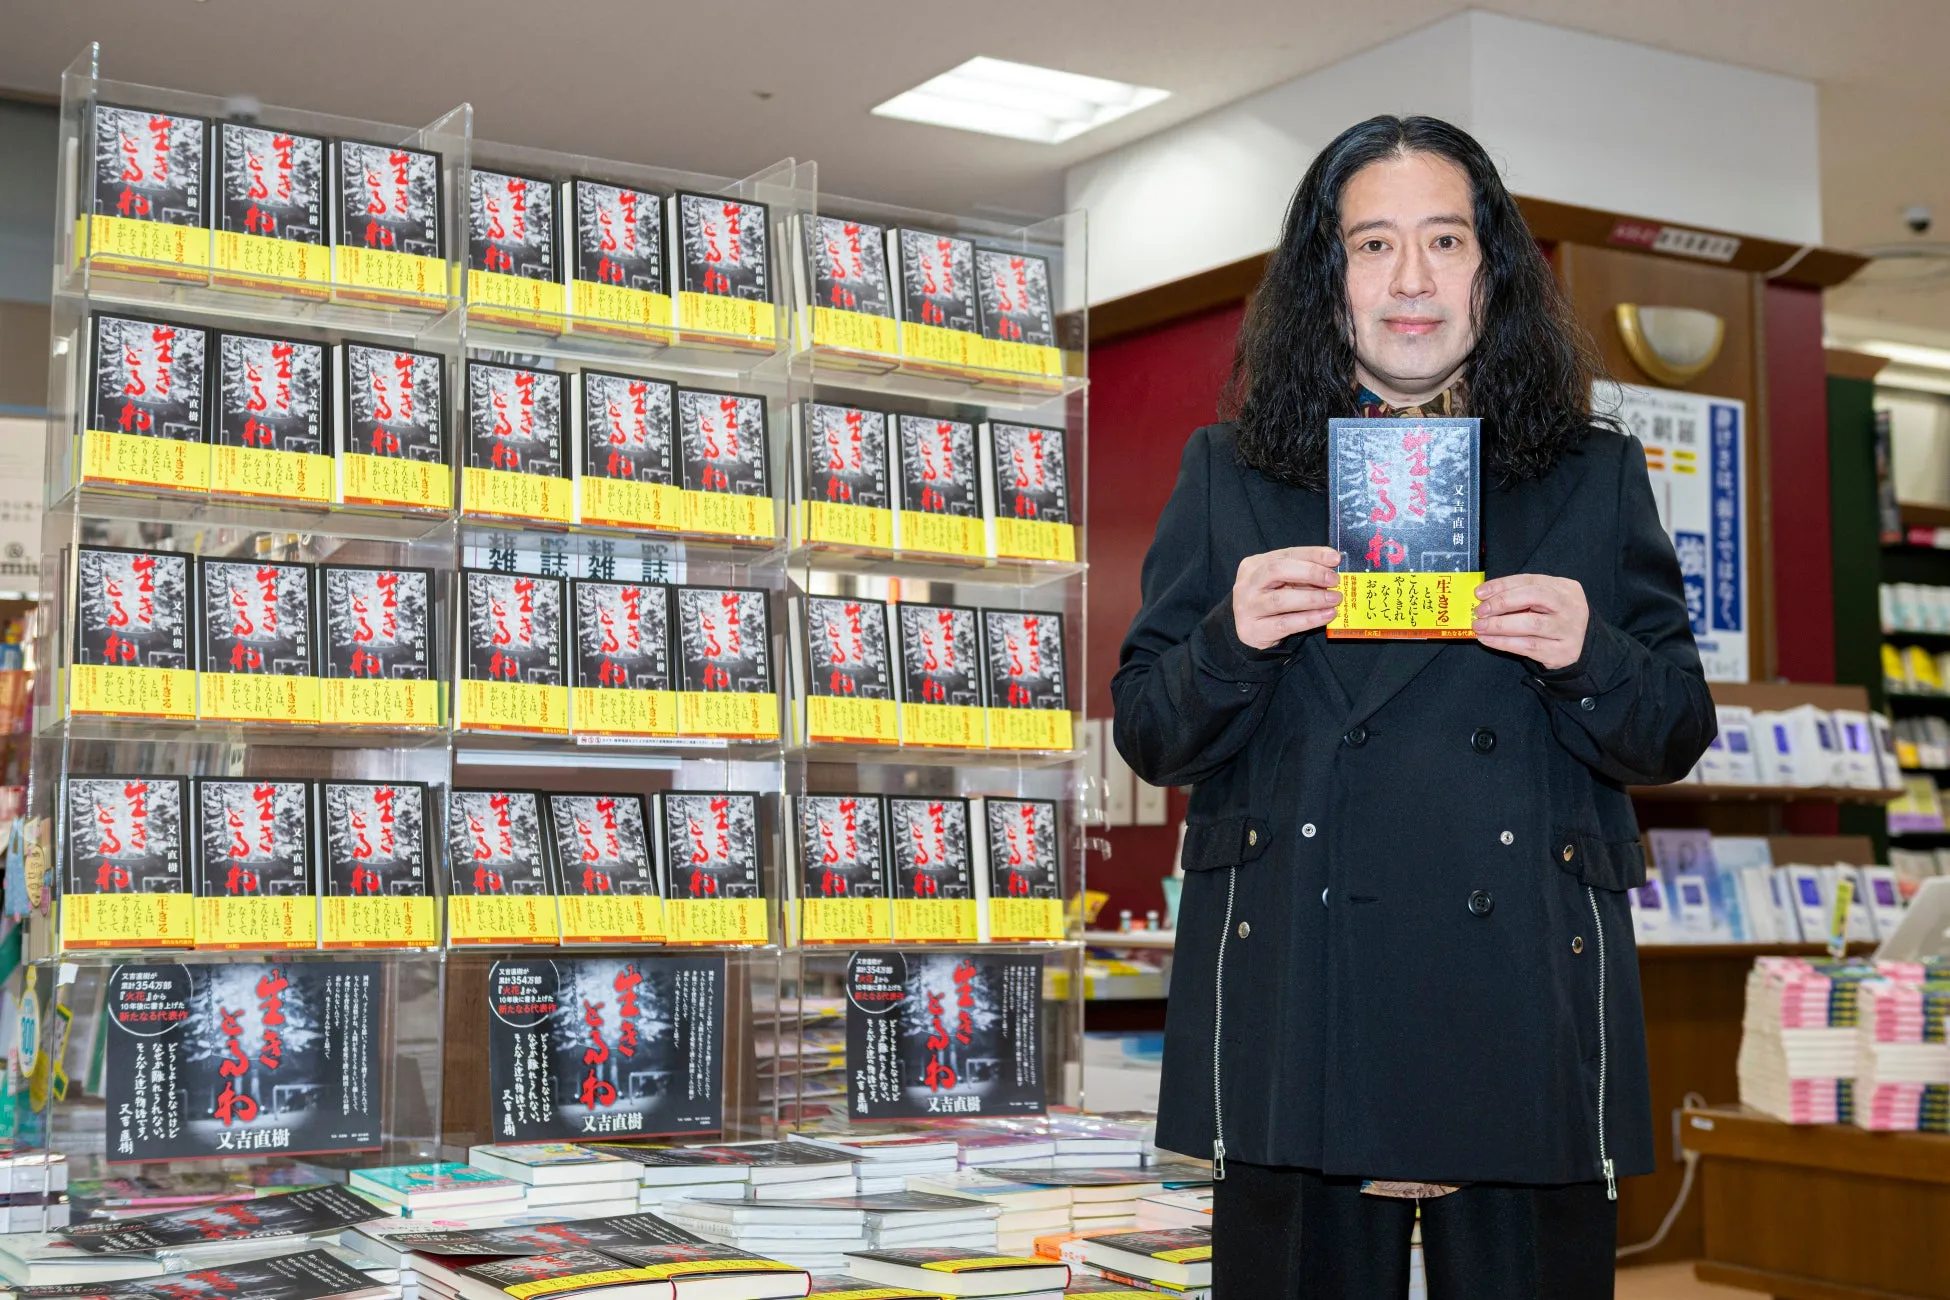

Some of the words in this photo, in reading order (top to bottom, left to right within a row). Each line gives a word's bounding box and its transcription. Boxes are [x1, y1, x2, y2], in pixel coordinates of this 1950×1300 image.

[116, 134, 150, 216] とるわ
[148, 113, 173, 181] 生き
[272, 132, 295, 199] 生き
[388, 148, 410, 214] 生き
[243, 152, 275, 233] とるわ
[364, 168, 394, 247] とるわ
[506, 176, 527, 239] 生き
[618, 188, 638, 251] 生き
[483, 194, 512, 271] とるわ
[596, 207, 623, 283] とるわ
[703, 220, 729, 293] とるわ
[722, 201, 742, 262] 生き
[118, 345, 152, 432] とるわ
[151, 323, 177, 395] 生き
[271, 340, 294, 410] 生き
[394, 351, 415, 419] 生き
[241, 362, 273, 446] とるわ
[370, 372, 399, 454] とるわ
[490, 390, 519, 469] とるわ
[514, 369, 536, 435] 生き
[628, 379, 648, 444] 生き
[719, 395, 739, 457] 生き
[606, 399, 633, 477] とるわ
[701, 415, 727, 490] とるわ
[1402, 424, 1432, 517] 生き
[1365, 459, 1405, 568] とるわ
[1452, 484, 1465, 546] 又吉直樹
[103, 577, 137, 663] とるわ
[131, 553, 157, 624] 生き
[255, 564, 280, 633] 生き
[376, 570, 399, 638] 生き
[513, 576, 535, 643] 生き
[621, 584, 641, 650] 生き
[721, 590, 741, 654] 生き
[1366, 580, 1378, 620] おかしい
[1380, 584, 1392, 622] なくて、
[1394, 576, 1405, 622] やりきれ
[1408, 574, 1418, 627] こんなにも
[1422, 586, 1434, 613] とは、
[1436, 575, 1452, 627] 「生きる」
[229, 588, 262, 671] とるわ
[349, 594, 381, 677] とるわ
[488, 598, 518, 679] とるわ
[597, 607, 627, 686] とるわ
[702, 613, 729, 690] とるわ
[95, 805, 130, 891] とるわ
[123, 779, 149, 849] 生き
[252, 782, 277, 853] 生き
[373, 785, 396, 854] 生き
[489, 792, 513, 856] 生き
[595, 796, 619, 857] 生き
[709, 795, 730, 859] 生き
[224, 808, 258, 895] とるわ
[350, 810, 380, 895] とるわ
[469, 815, 502, 893] とるわ
[578, 819, 610, 893] とるわ
[688, 819, 717, 897] とるわ
[256, 969, 288, 1069] 生き
[614, 964, 642, 1057] 生き
[952, 960, 977, 1045] 生き
[214, 1006, 258, 1126] とるわ
[580, 999, 616, 1111] とるわ
[924, 990, 956, 1094] とるわ
[216, 1128, 290, 1150] 又吉直樹
[582, 1112, 644, 1133] 又吉直樹
[927, 1096, 982, 1113] 又吉直樹
